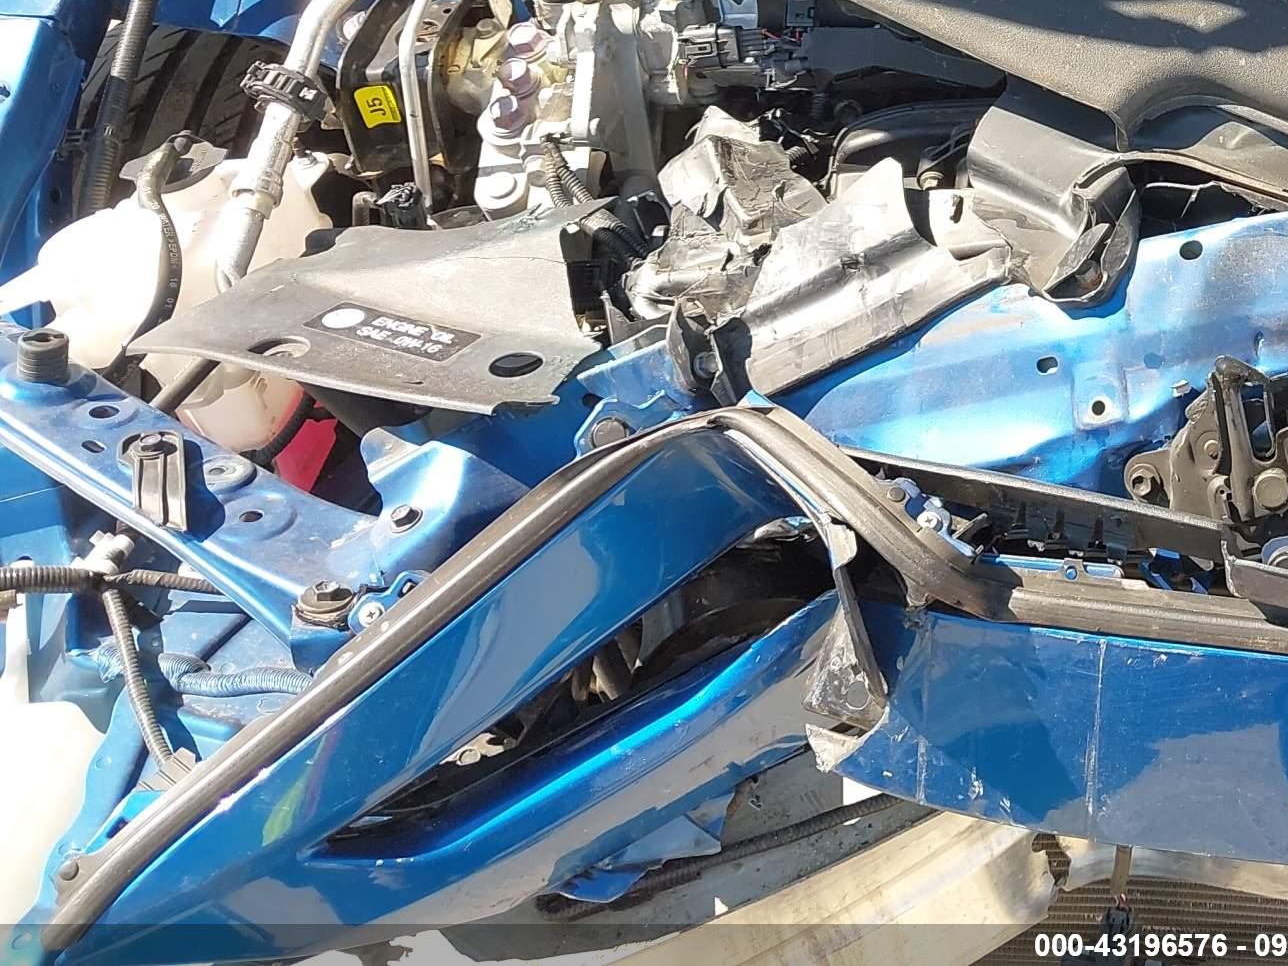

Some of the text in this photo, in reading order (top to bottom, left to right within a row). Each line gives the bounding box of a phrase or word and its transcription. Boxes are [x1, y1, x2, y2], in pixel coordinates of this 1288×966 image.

[366, 97, 387, 116] J5
[356, 326, 443, 354] SAE 0W-16
[371, 316, 456, 344] ENGINE OIL
